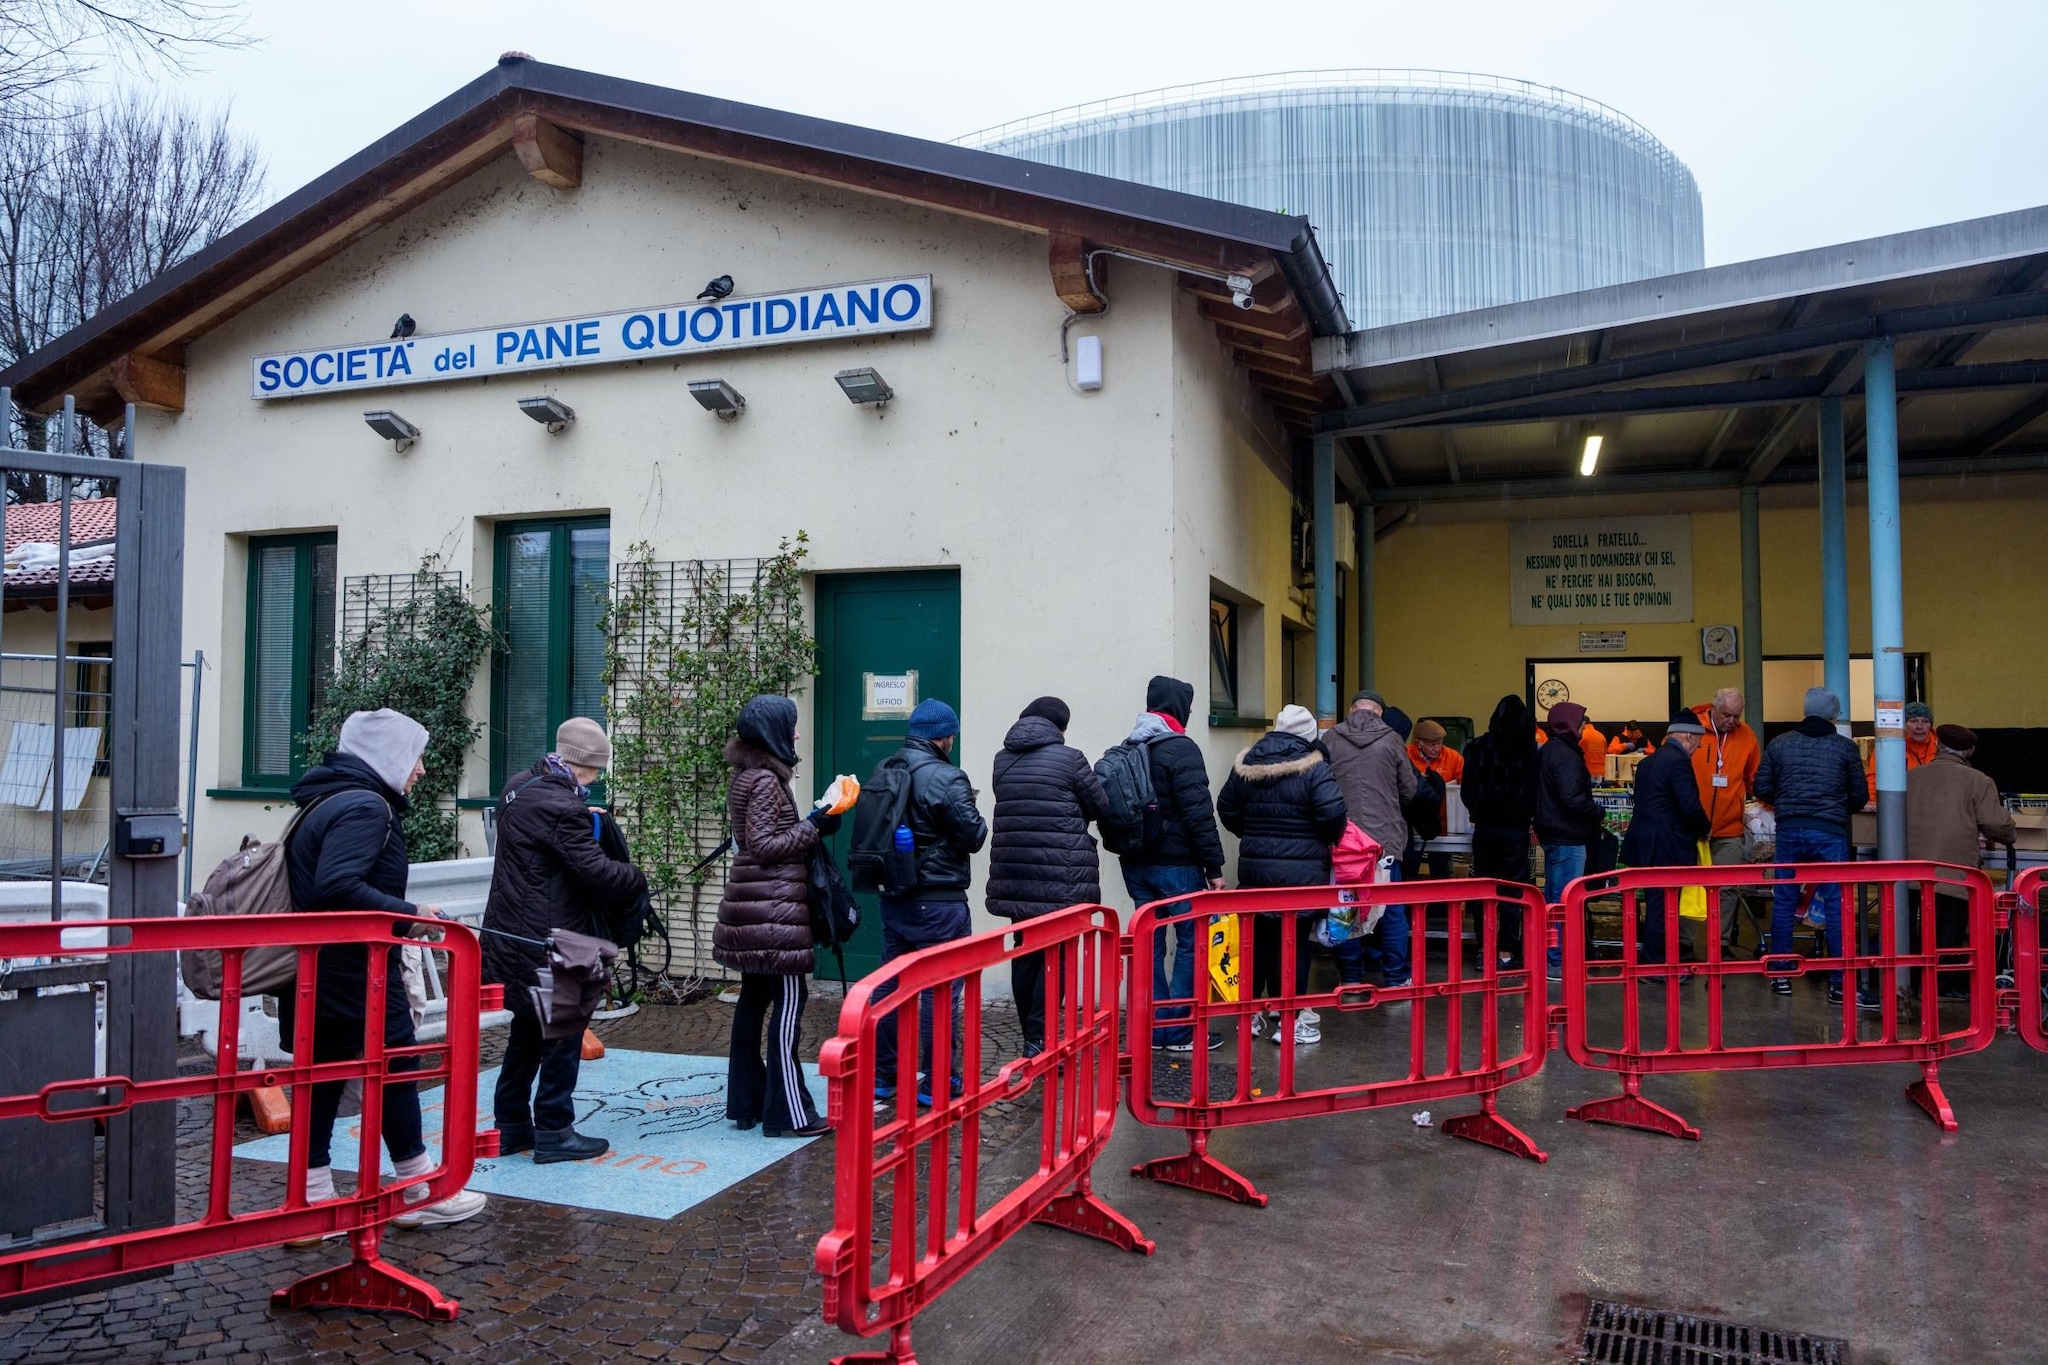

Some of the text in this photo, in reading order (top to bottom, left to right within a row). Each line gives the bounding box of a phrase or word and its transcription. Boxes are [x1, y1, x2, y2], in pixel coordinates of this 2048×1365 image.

[434, 344, 475, 372] del
[496, 320, 600, 365] PANE
[622, 283, 921, 350] QUOTIDIANO
[1552, 532, 1647, 549] SORELLA FRATELLO...
[1526, 551, 1676, 571] NESSUNO QUI TI DOMANDERA' CHI SEI,
[1545, 572, 1656, 589] NE' PERCHE' HAI BISOGNO,
[1531, 591, 1672, 610] NE' QUALI SONO LE TUE OPINIONI
